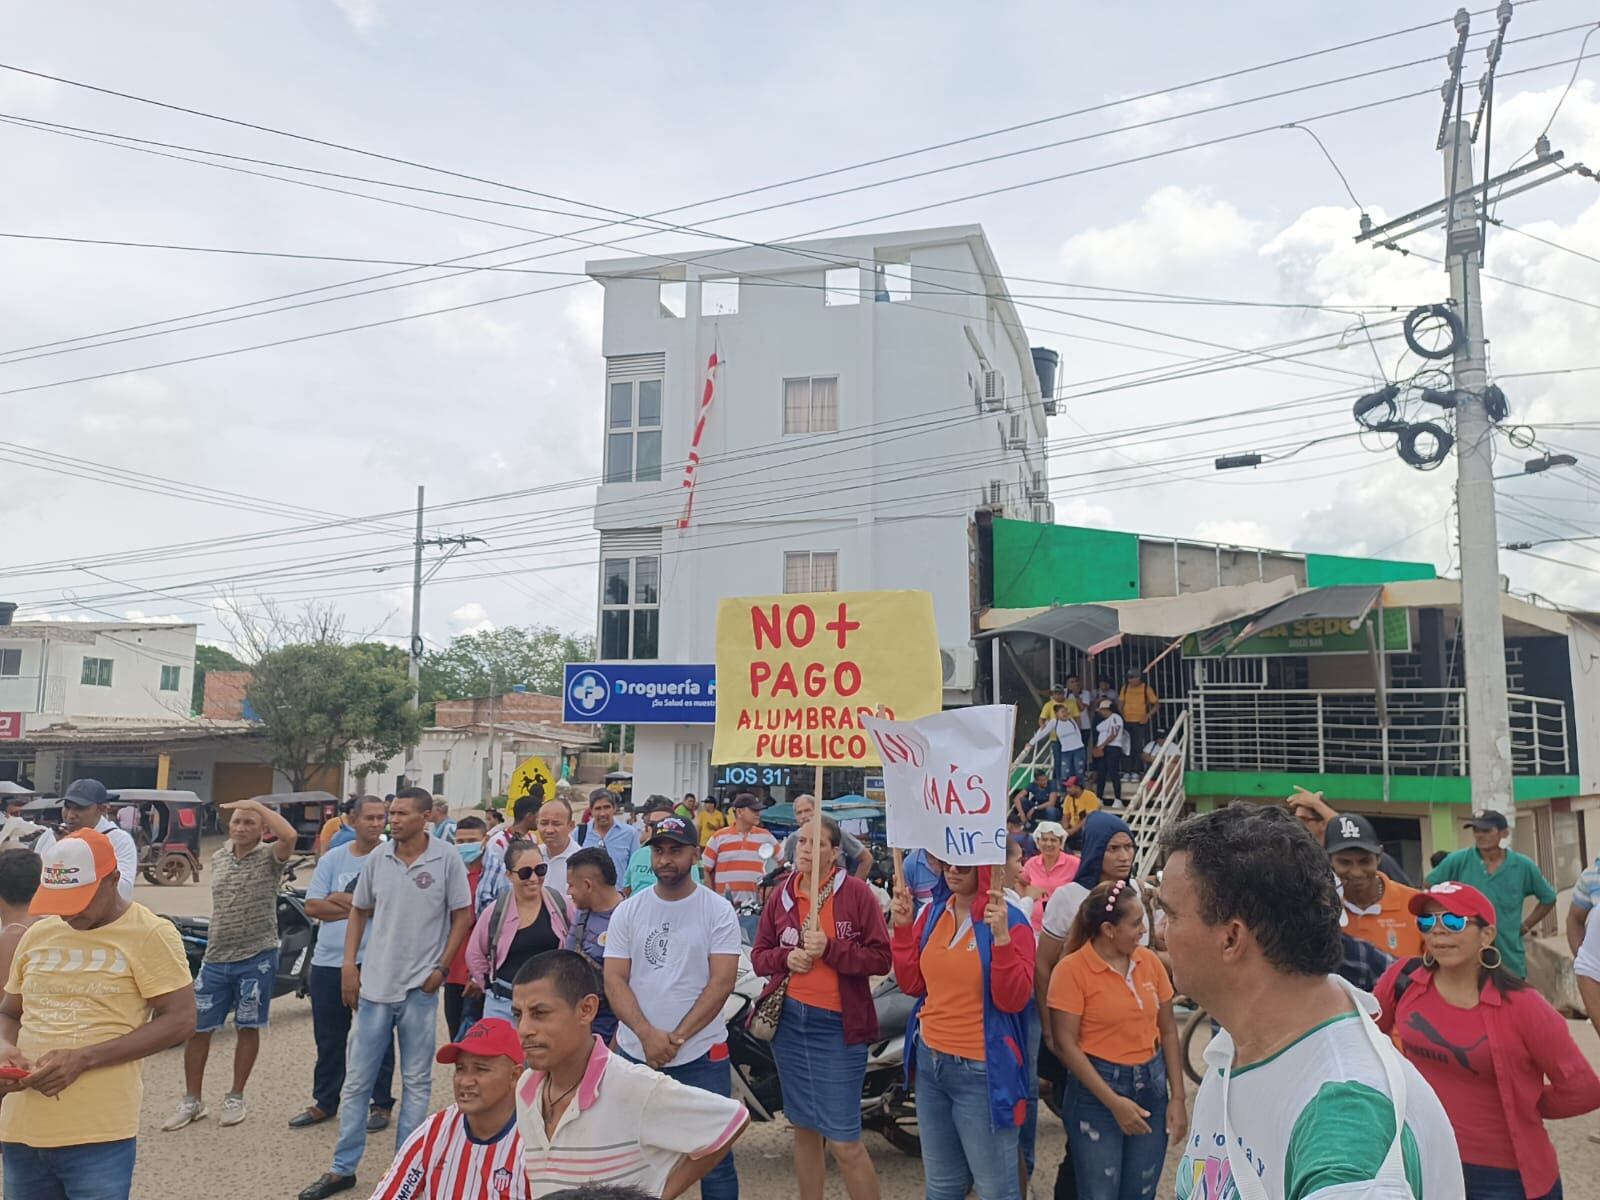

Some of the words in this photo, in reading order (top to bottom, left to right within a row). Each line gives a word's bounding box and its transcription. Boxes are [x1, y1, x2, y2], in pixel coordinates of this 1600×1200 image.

[751, 604, 815, 650] NO
[825, 602, 860, 649] +
[615, 679, 701, 698] Droguería
[750, 661, 862, 698] PAGO
[664, 699, 684, 707] Salud
[756, 733, 867, 760] PUBLICO
[874, 729, 924, 767] NO
[923, 763, 991, 815] MÁS
[1339, 816, 1361, 838] LA
